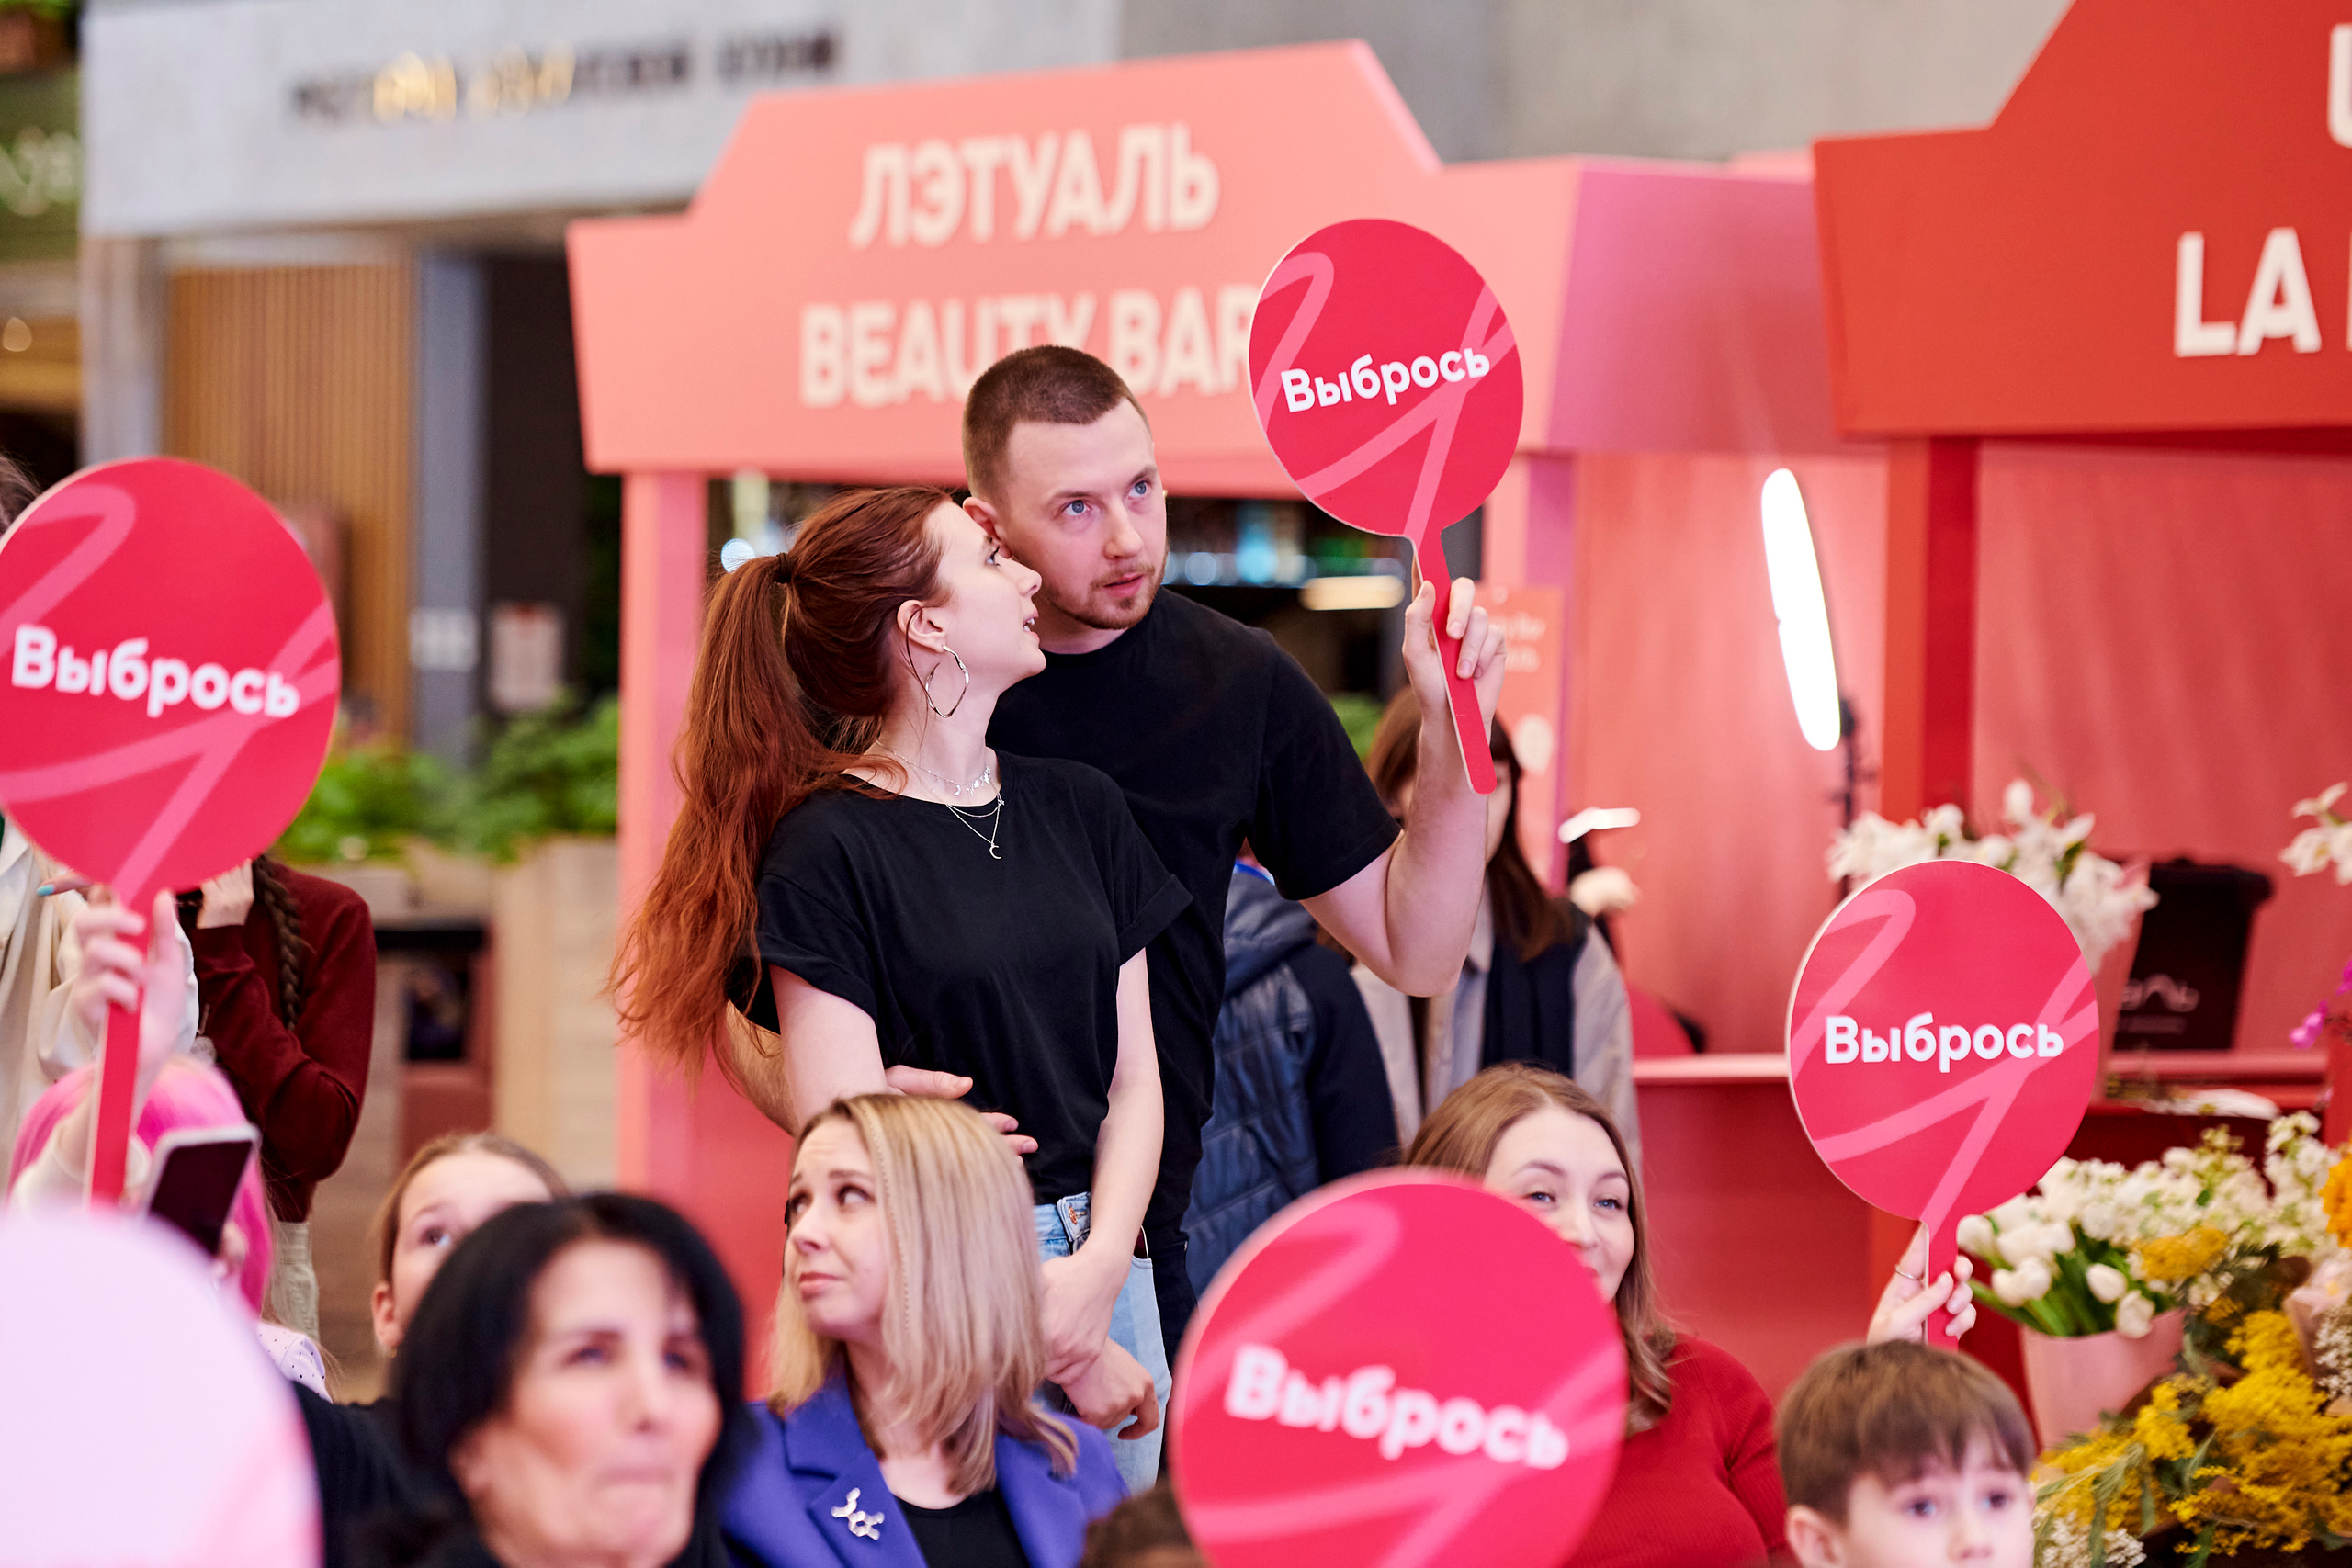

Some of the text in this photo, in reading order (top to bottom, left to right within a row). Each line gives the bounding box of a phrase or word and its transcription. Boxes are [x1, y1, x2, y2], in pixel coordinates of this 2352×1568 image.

[850, 122, 1220, 250] ЛЭТУАЛЬ
[802, 286, 1259, 408] BEAUTY BAR
[2175, 227, 2322, 357] LA
[1281, 347, 1490, 413] Выбрось
[11, 624, 301, 718] Выбрось
[1825, 1011, 2064, 1073] Выбрось
[1225, 1343, 1569, 1470] Выбрось
